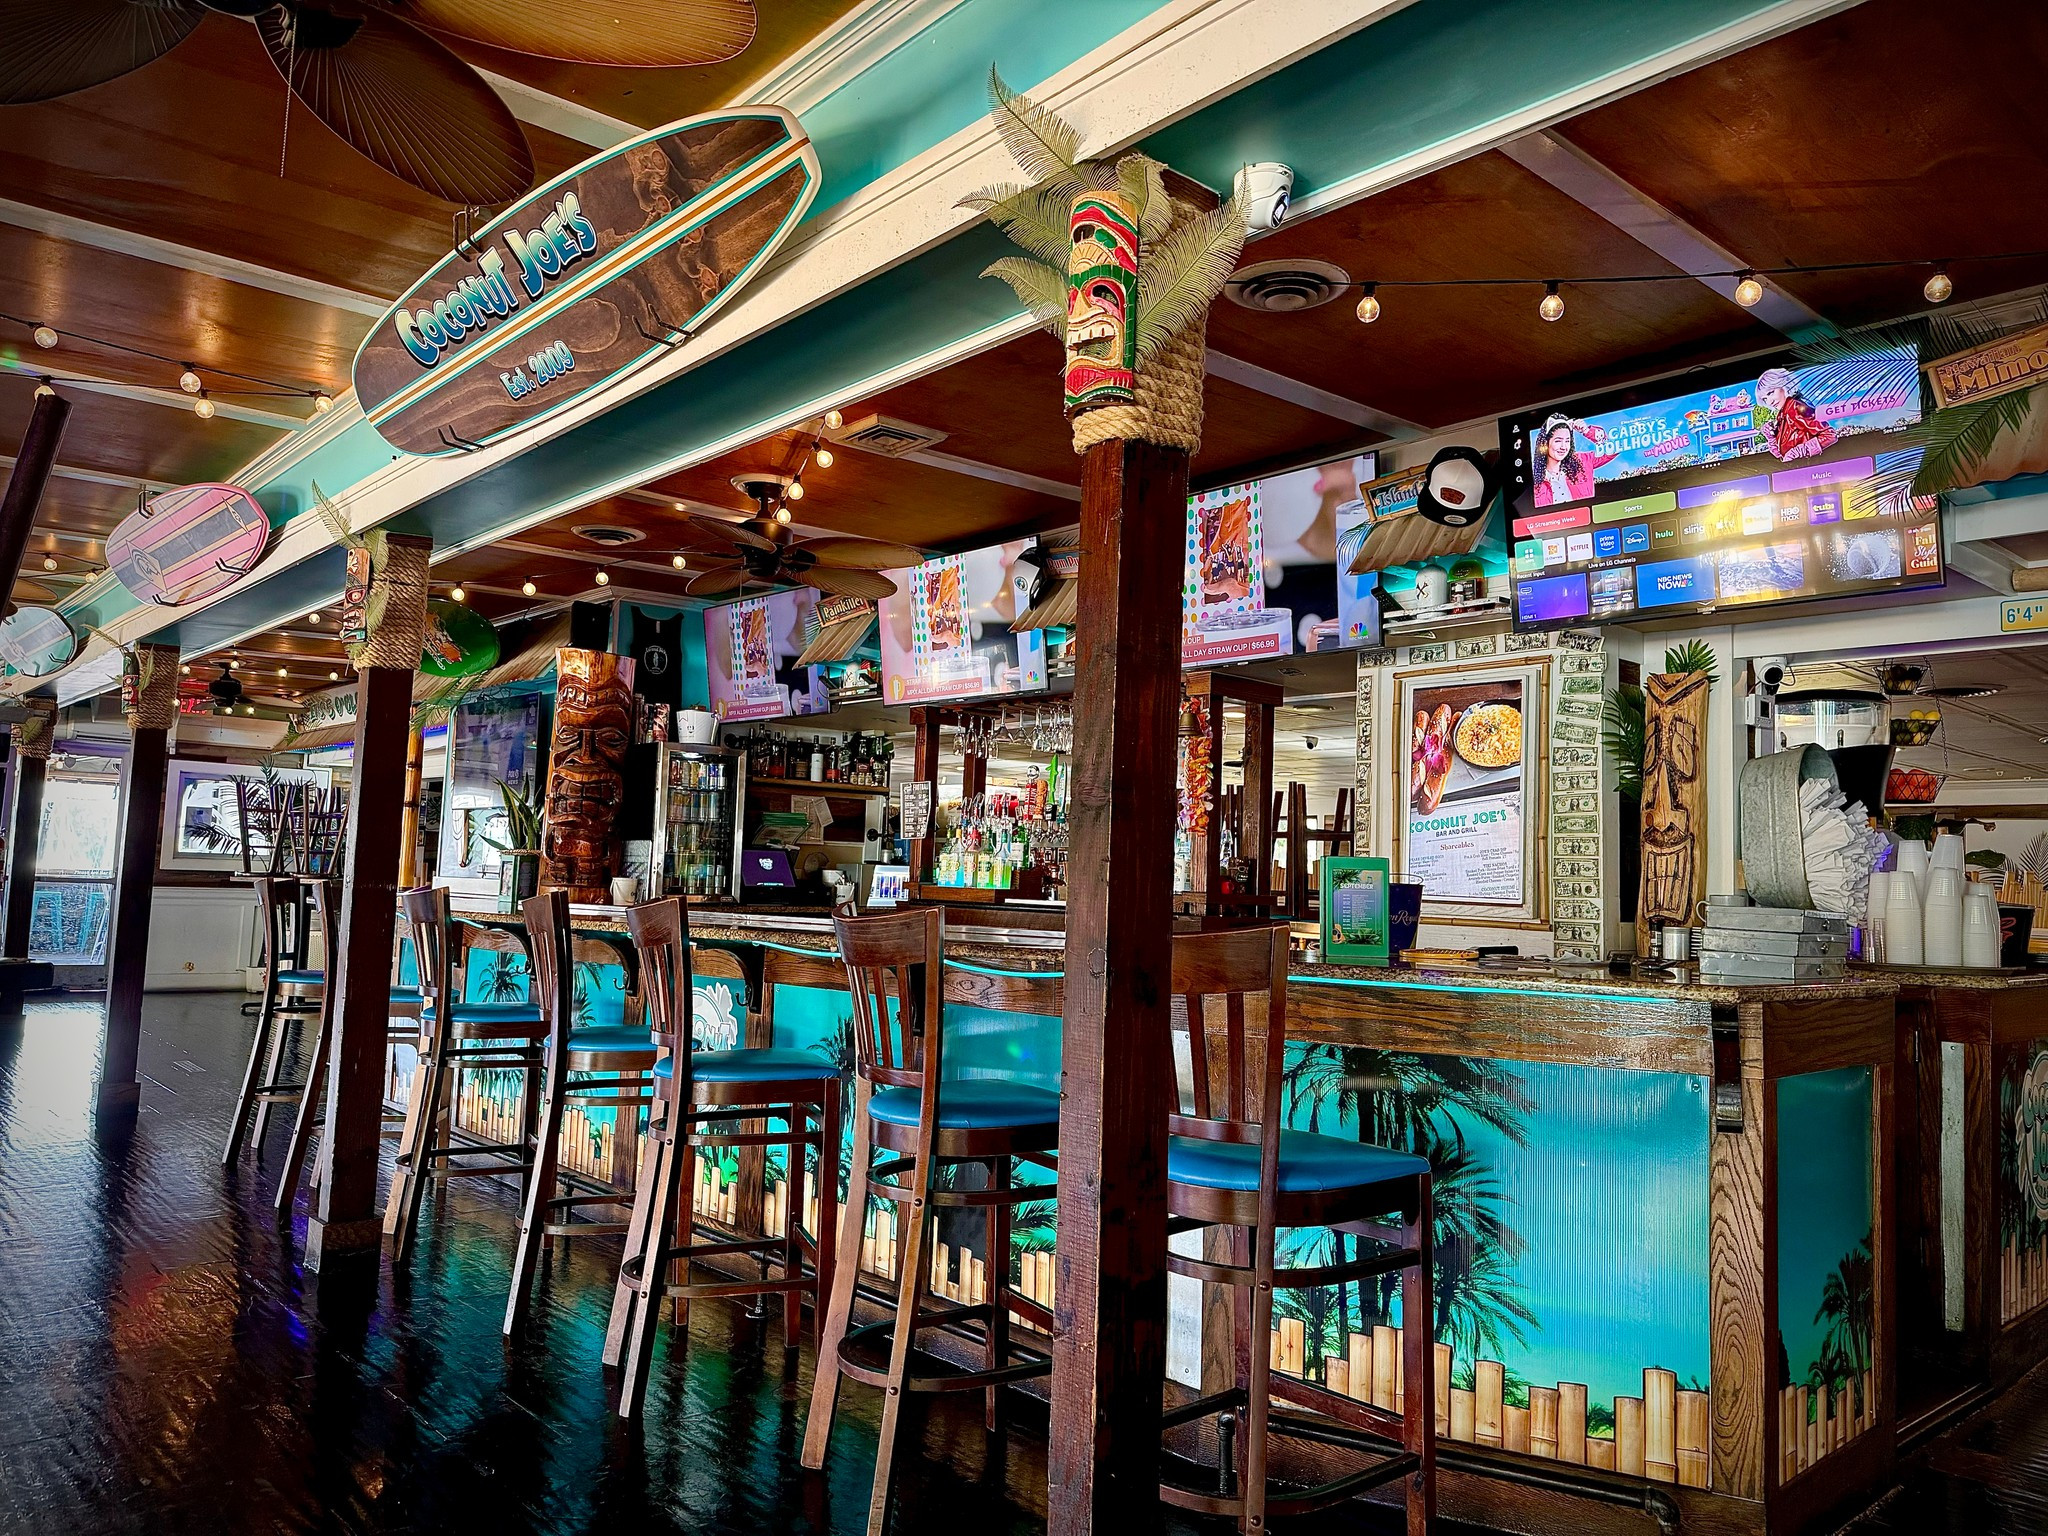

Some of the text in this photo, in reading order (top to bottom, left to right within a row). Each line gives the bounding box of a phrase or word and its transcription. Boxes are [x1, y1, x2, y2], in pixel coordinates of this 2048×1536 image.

[394, 191, 598, 368] COCONUT JOE'S
[1944, 345, 2021, 376] Hawaiian
[499, 340, 575, 400] Est. 2009
[1958, 350, 2048, 393] Mimo
[1825, 394, 1896, 416] GET TICKETS
[1608, 418, 1667, 440] GABBY'S
[1595, 428, 1680, 458] DOLLHOUSE
[1653, 434, 1690, 457] MOVIE
[1811, 470, 1832, 480] Music
[1378, 484, 1420, 507] Island
[1624, 503, 1643, 513] Sports
[1780, 506, 1799, 516] HBO
[1535, 517, 1561, 529] Streaming
[1562, 515, 1576, 524] Week
[1655, 529, 1674, 539] hulu
[1683, 524, 1705, 535] sling
[1599, 535, 1615, 544] prime
[1600, 540, 1615, 548] video
[1915, 534, 1936, 546] Fall
[1570, 543, 1590, 552] NETFLIX
[1614, 557, 1637, 566] Channels
[1657, 572, 1693, 583] NBC NEWS
[1658, 580, 1682, 591] NOW
[2006, 605, 2043, 623] 6'4"
[1187, 636, 1201, 645] CUP
[1193, 649, 1207, 657] DAY
[1208, 646, 1232, 655] STRAW
[1234, 644, 1248, 653] CUP
[1251, 640, 1275, 650] $56.99
[952, 683, 963, 691] CUP
[1410, 809, 1507, 833] COCONUT JOE'S
[1461, 826, 1478, 834] GRILL
[1440, 841, 1475, 851] Shareables
